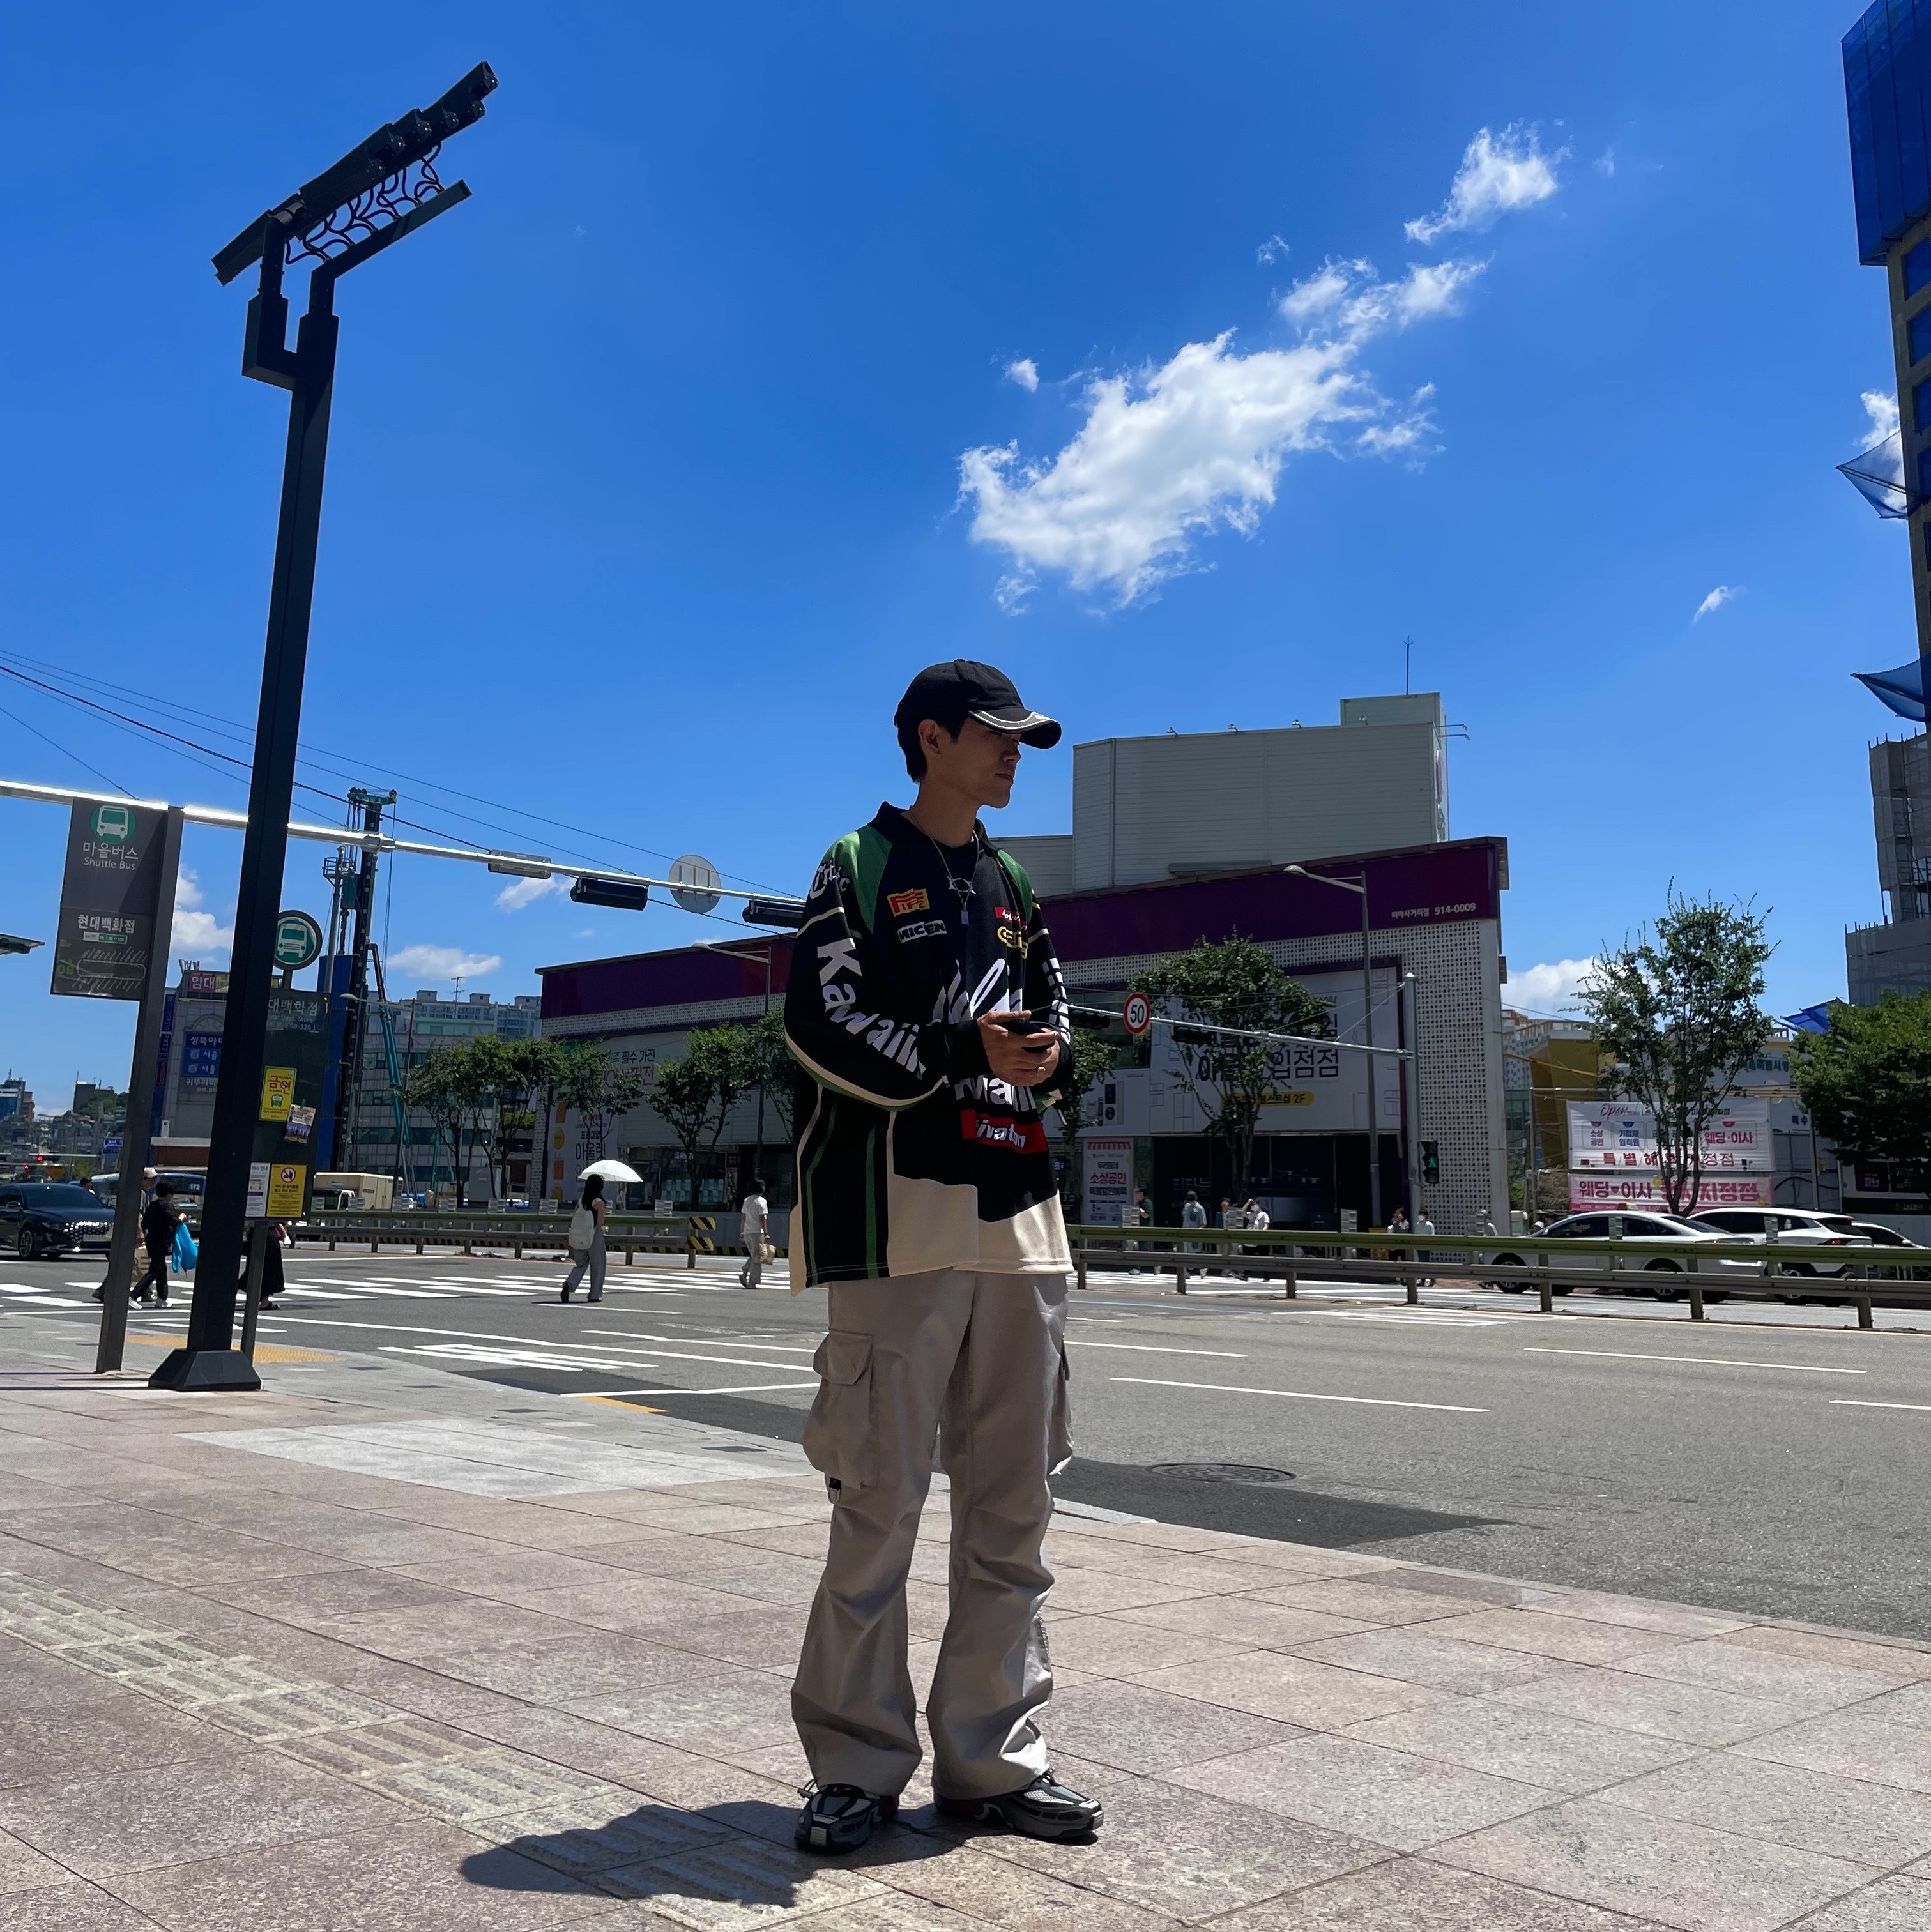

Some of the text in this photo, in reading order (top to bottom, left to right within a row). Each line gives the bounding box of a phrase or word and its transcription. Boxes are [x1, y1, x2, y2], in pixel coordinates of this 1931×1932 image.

[82, 841, 139, 859] 마을버스
[84, 857, 135, 871] Shuttle Bus
[1435, 902, 1476, 915] 914-0009
[78, 913, 135, 934] 현대백화점
[192, 975, 215, 990] 임대
[1130, 1004, 1144, 1024] 50
[203, 1049, 218, 1060] 서울
[622, 1051, 637, 1064] 필수
[639, 1049, 655, 1063] 가전
[1271, 1049, 1338, 1079] 입점점
[1293, 1093, 1306, 1104] 2F
[575, 1141, 606, 1160] 아울렛
[1090, 1172, 1126, 1184] 소상공인
